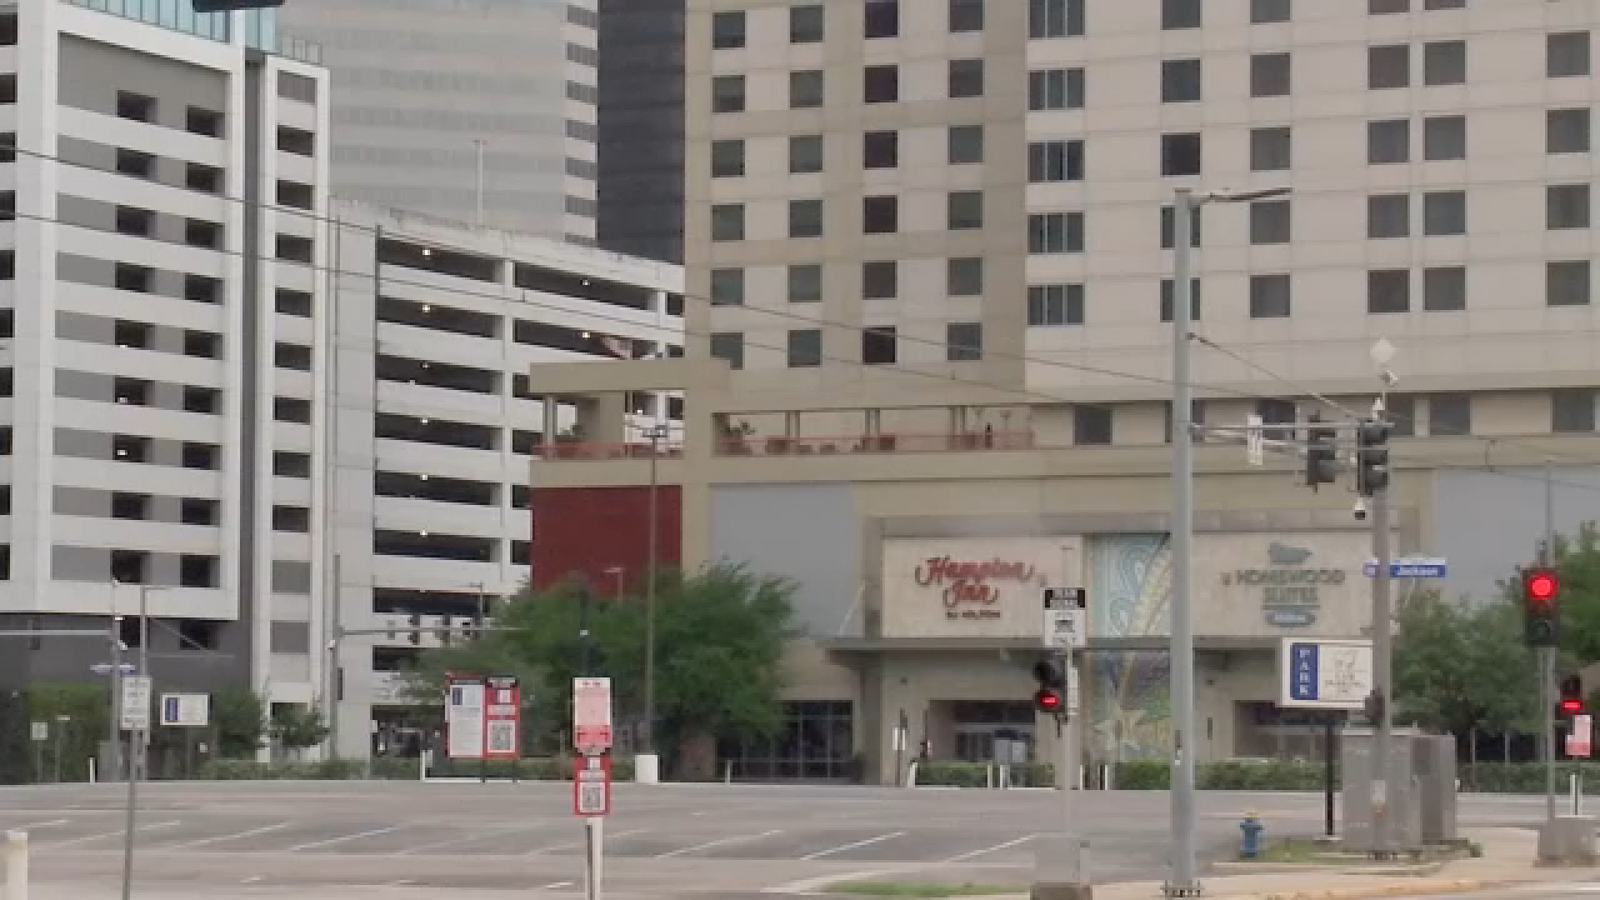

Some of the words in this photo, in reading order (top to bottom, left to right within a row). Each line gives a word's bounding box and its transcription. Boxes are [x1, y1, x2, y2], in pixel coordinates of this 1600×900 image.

[915, 555, 1035, 586] Hampton
[1236, 569, 1345, 585] HOMEWOOD
[943, 579, 998, 607] Inn
[1299, 649, 1311, 696] PARK
